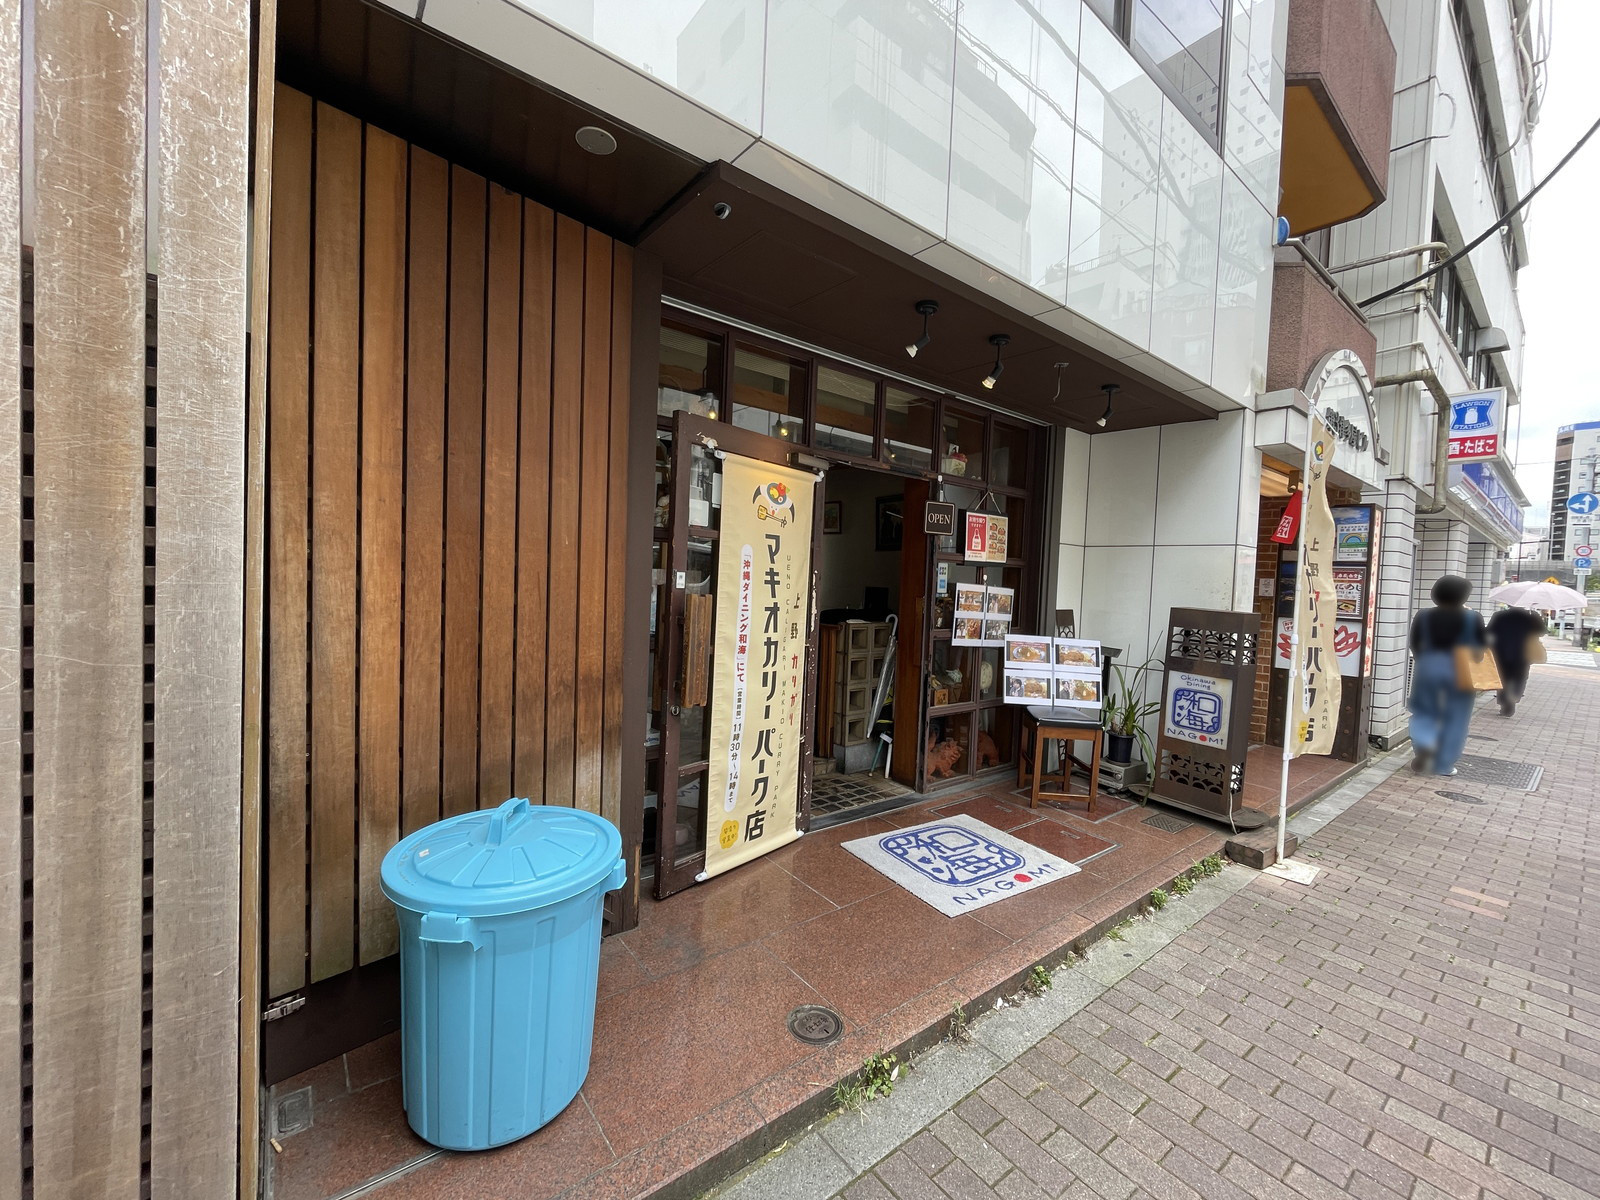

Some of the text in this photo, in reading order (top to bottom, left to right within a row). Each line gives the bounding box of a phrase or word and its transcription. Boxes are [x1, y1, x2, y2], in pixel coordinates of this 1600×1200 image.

[1454, 400, 1491, 410] LAWSON
[1453, 421, 1489, 430] STATION
[928, 512, 951, 525] OPEN
[1309, 537, 1320, 578] 上野
[790, 592, 801, 640] 上野
[782, 598, 790, 671] CALIGARI
[744, 533, 781, 843] マキオカリーパーク店
[1180, 674, 1216, 686] Okinawa
[1186, 681, 1212, 691] Dining
[1321, 699, 1329, 730] PARK
[775, 733, 784, 777] CURRY
[769, 785, 779, 818] PARK
